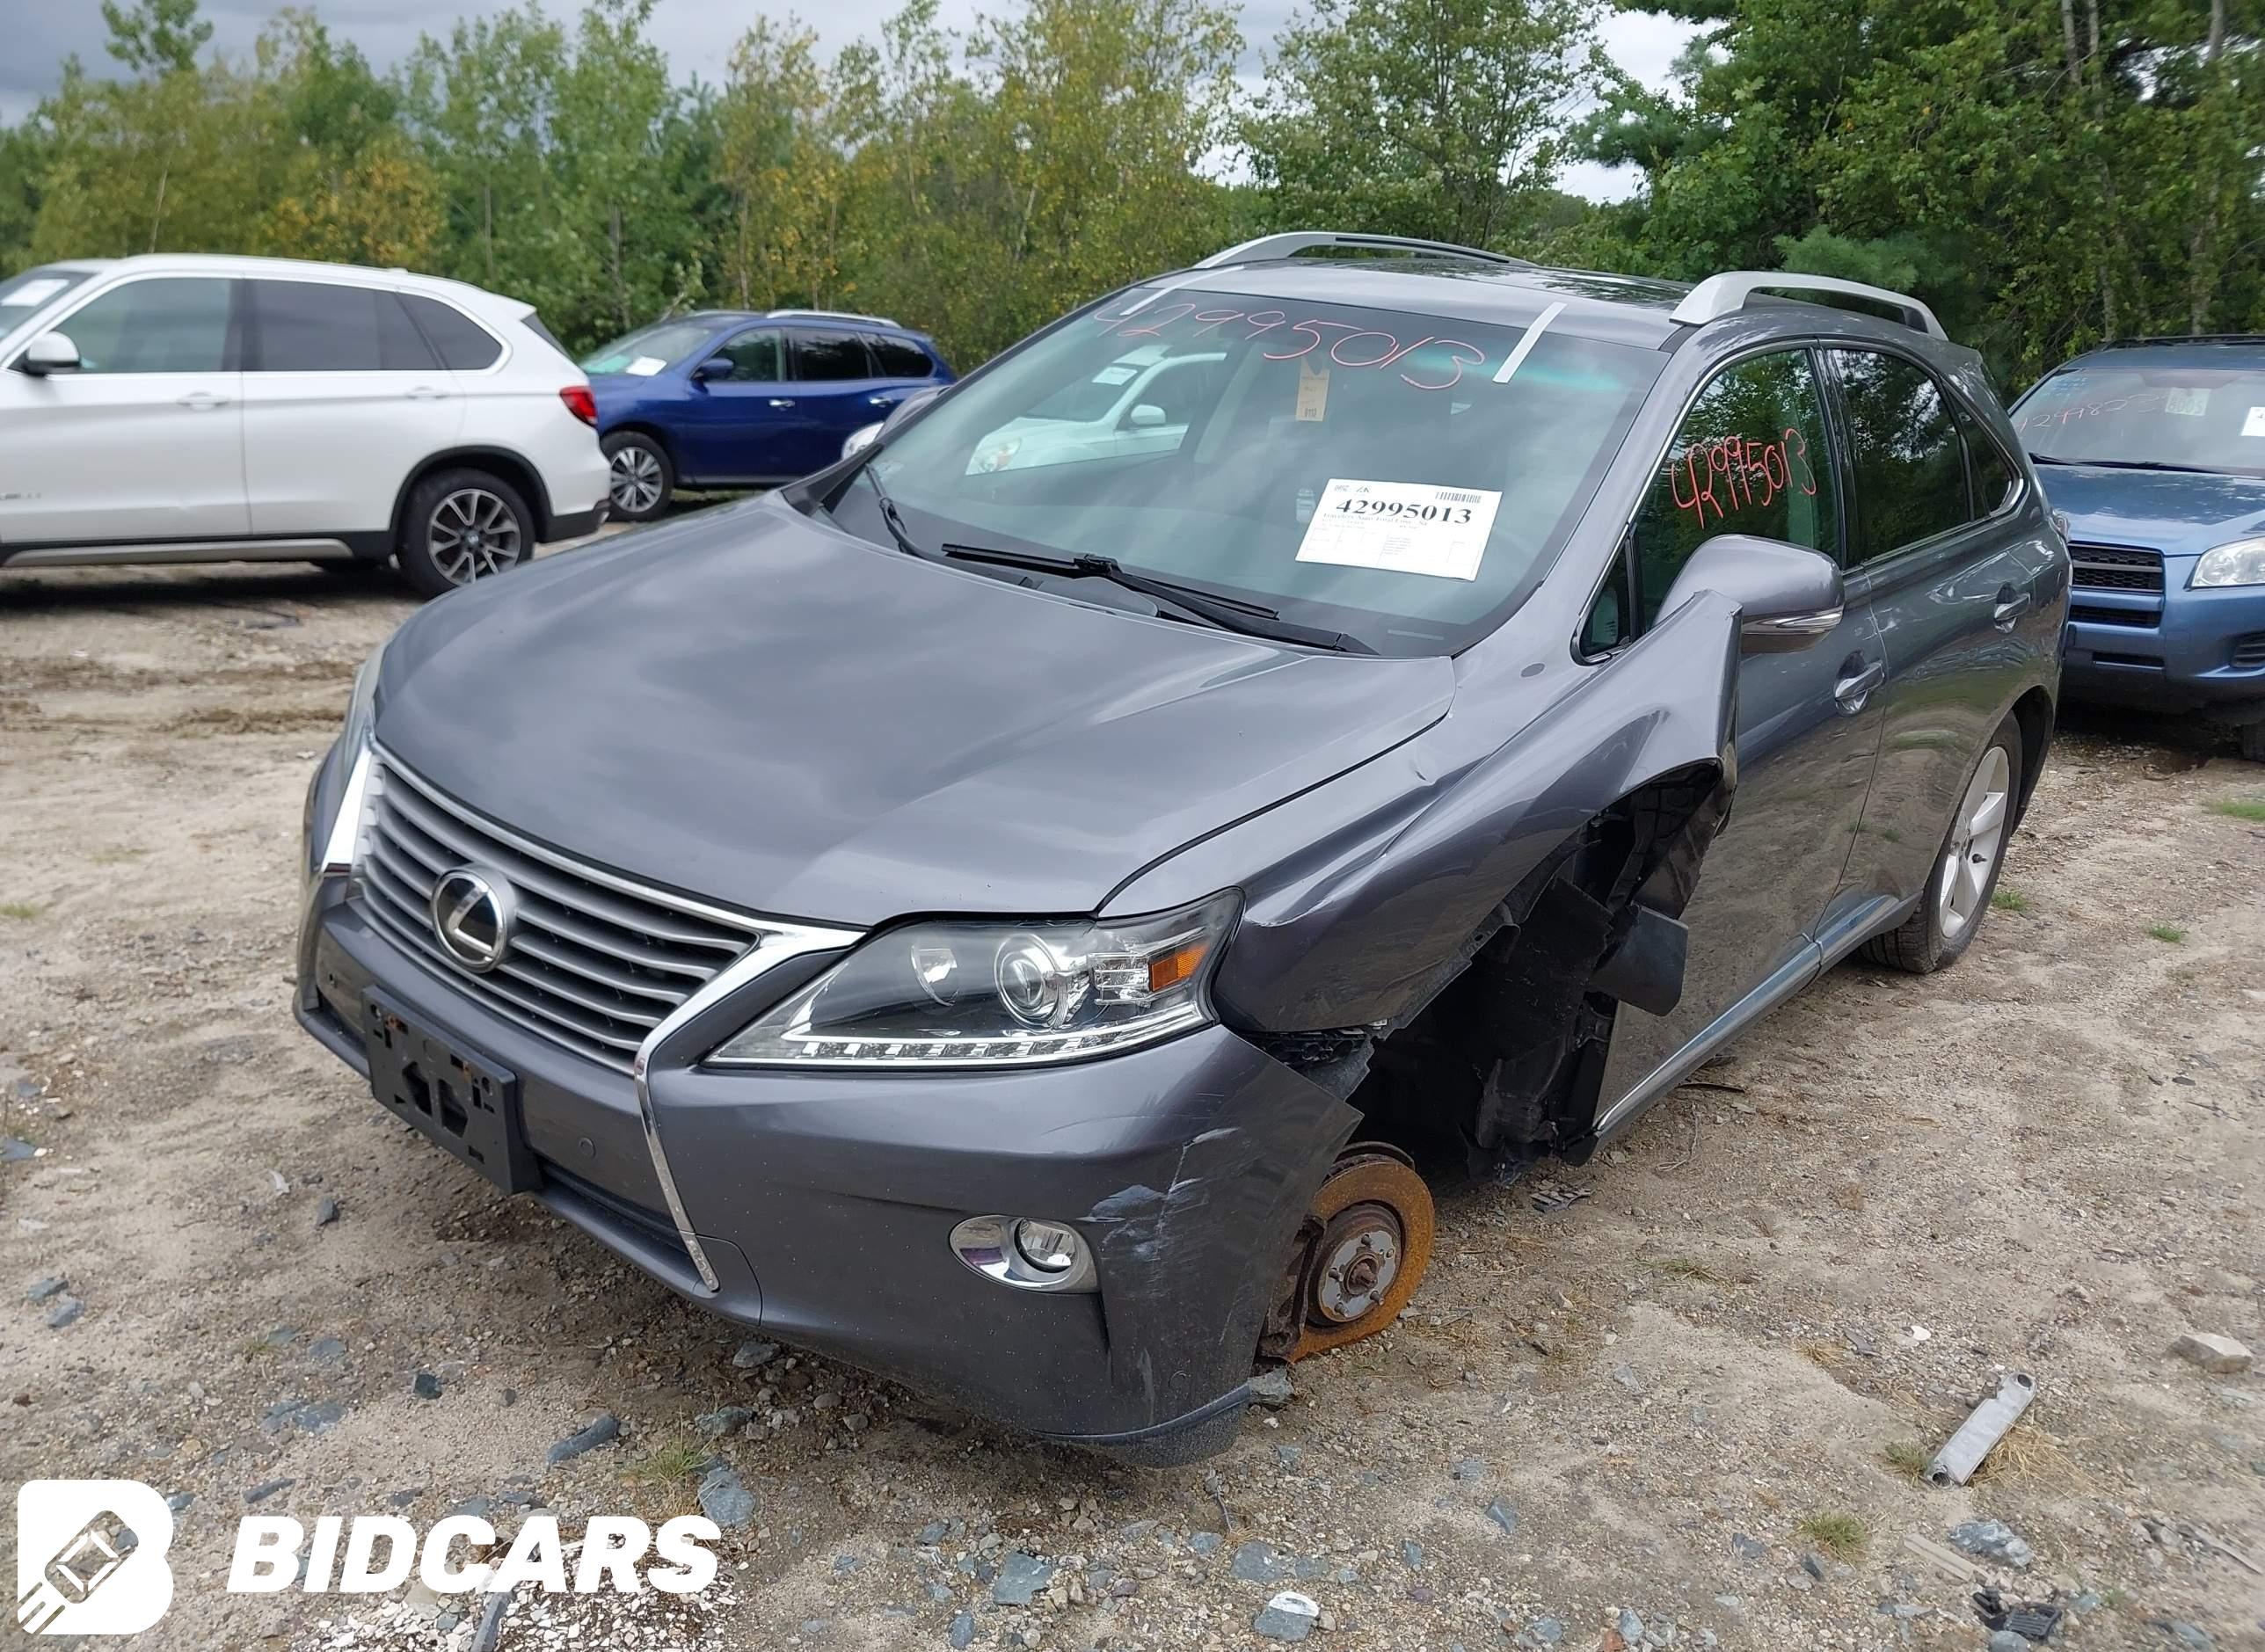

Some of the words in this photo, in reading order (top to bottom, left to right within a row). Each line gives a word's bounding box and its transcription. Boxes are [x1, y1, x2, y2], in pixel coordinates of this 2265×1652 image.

[1094, 301, 1485, 389] 42995013
[1335, 498, 1473, 525] 42995013
[1671, 427, 1817, 529] 42995013
